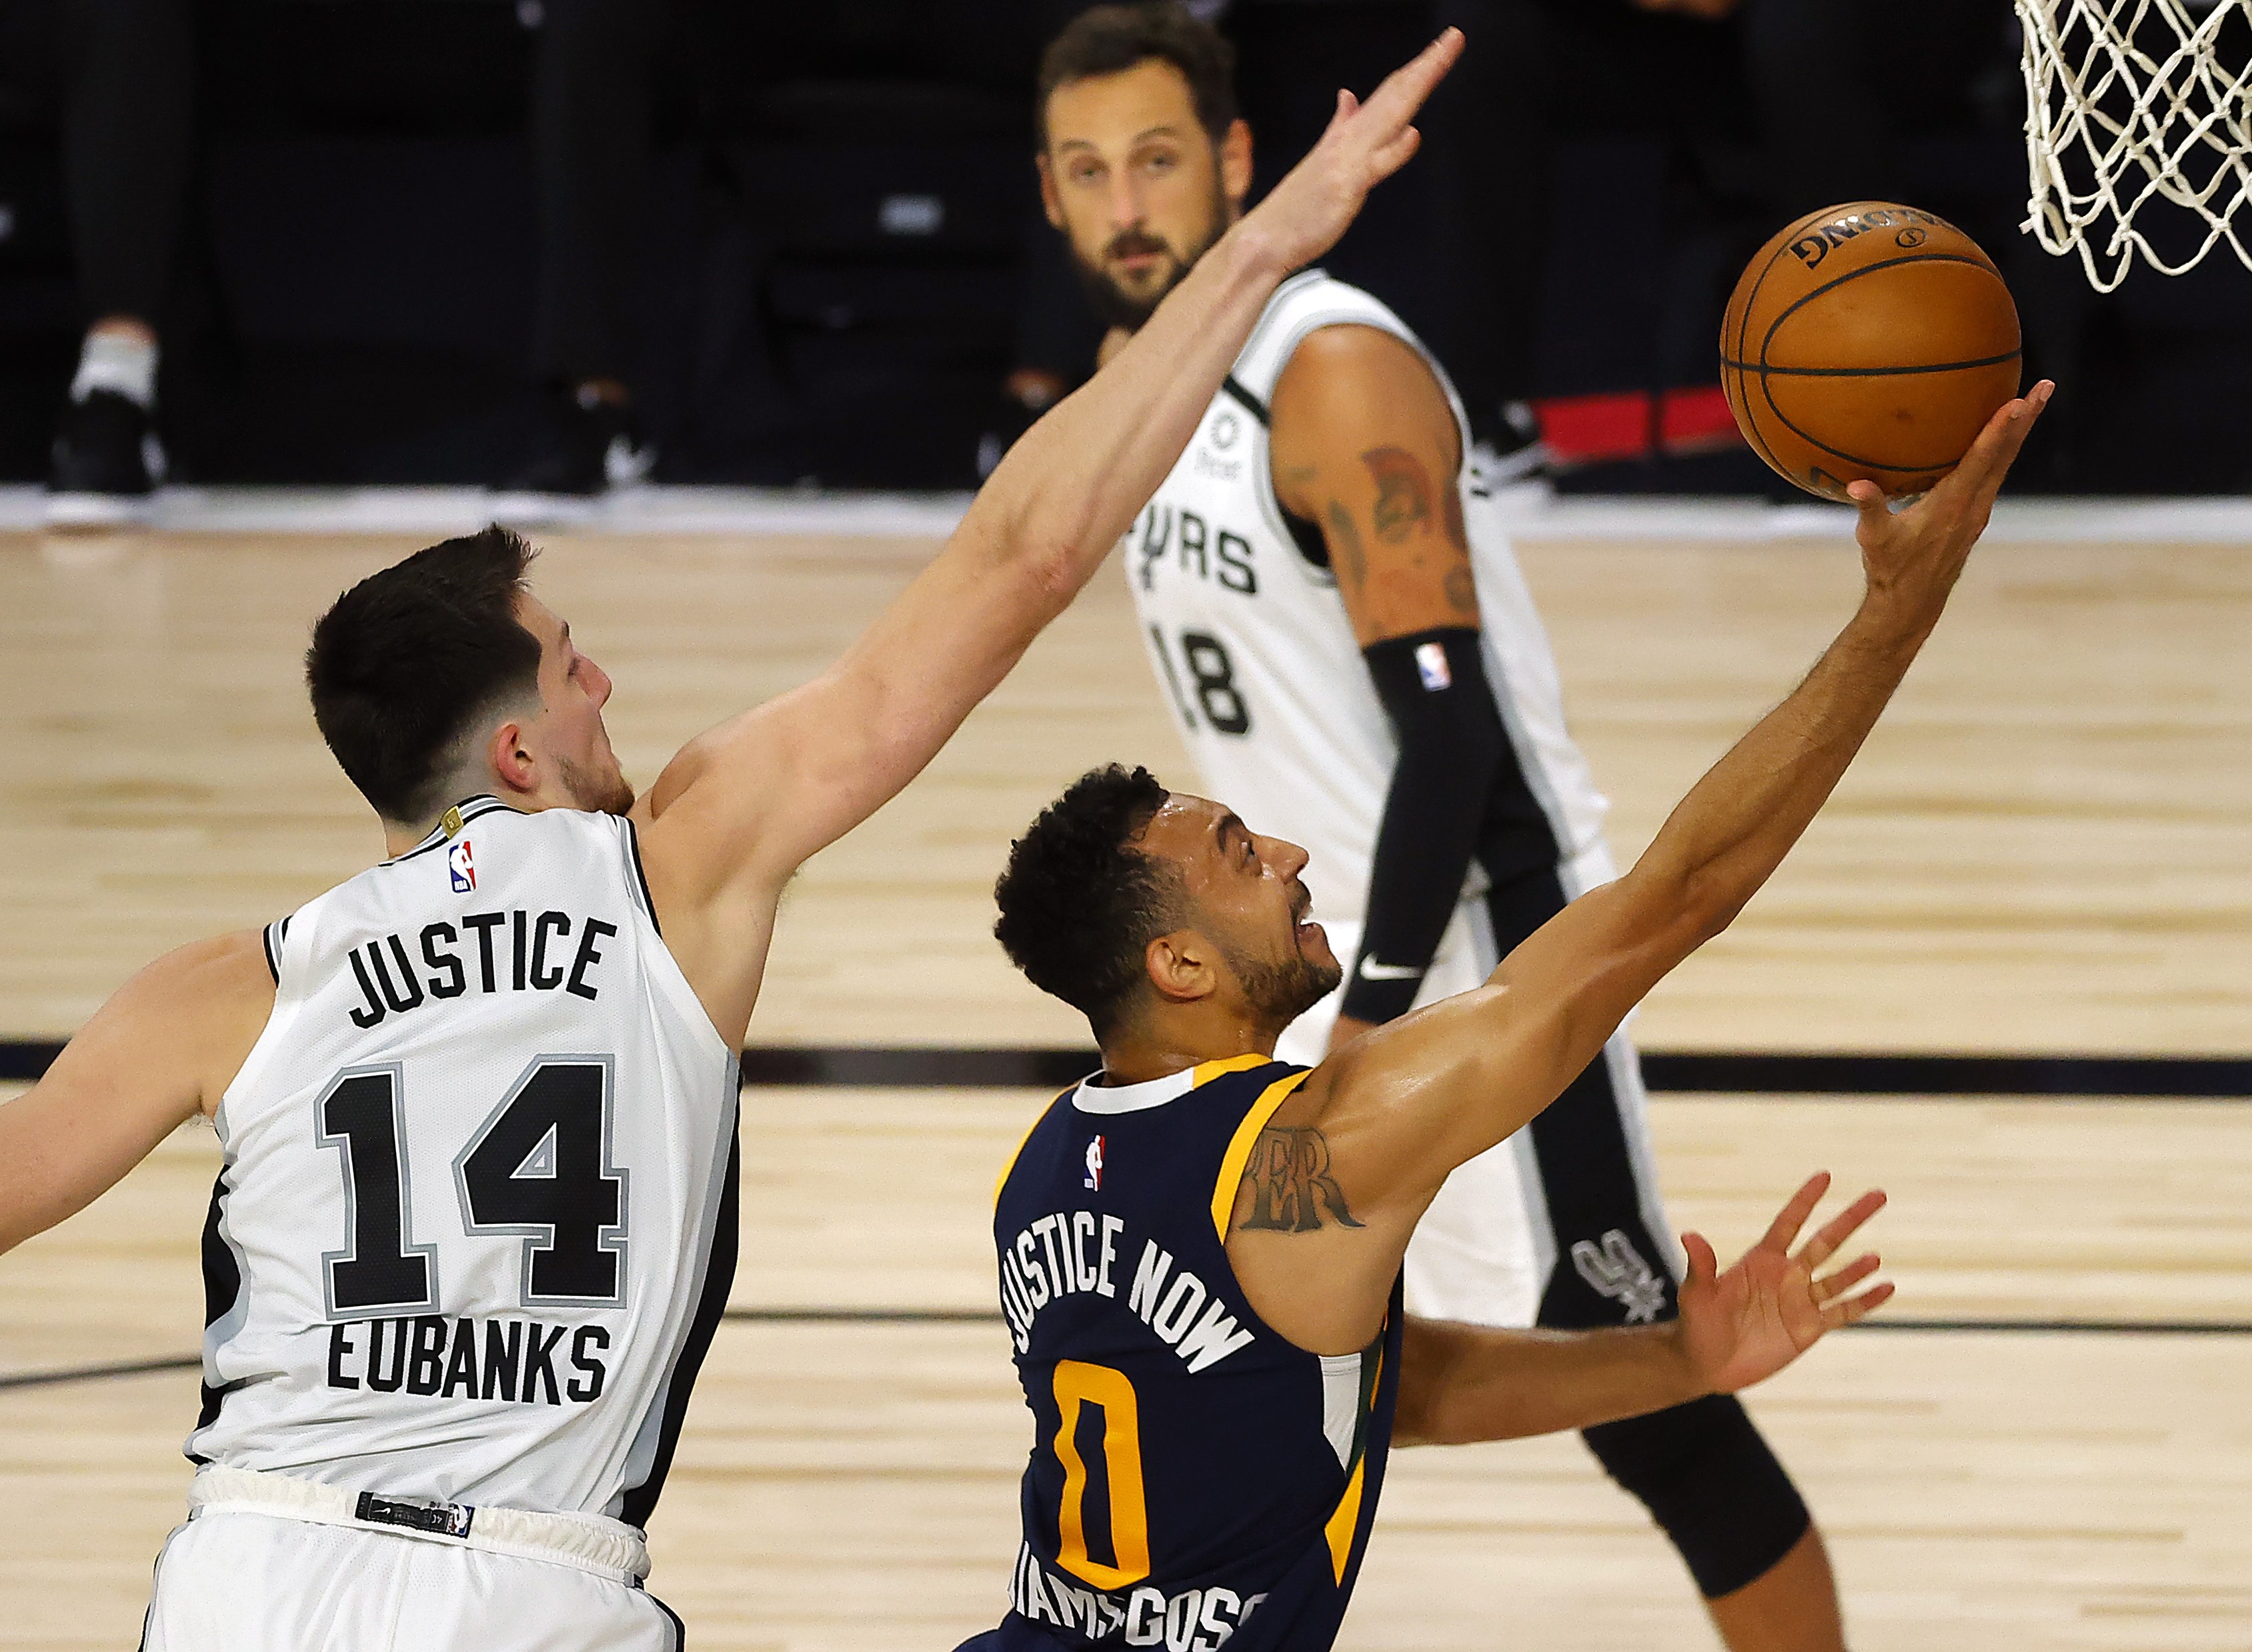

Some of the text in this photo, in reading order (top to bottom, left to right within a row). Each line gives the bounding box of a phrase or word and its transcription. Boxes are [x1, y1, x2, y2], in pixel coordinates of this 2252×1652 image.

[1149, 623, 1252, 736] 18
[453, 879, 468, 891] NBA
[348, 909, 618, 1029] JUSTICE
[313, 1053, 630, 1321] 14
[1002, 1211, 1255, 1375] JUSTICE NOW
[327, 1315, 611, 1406] EUBANKS
[1052, 1359, 1151, 1591] 0
